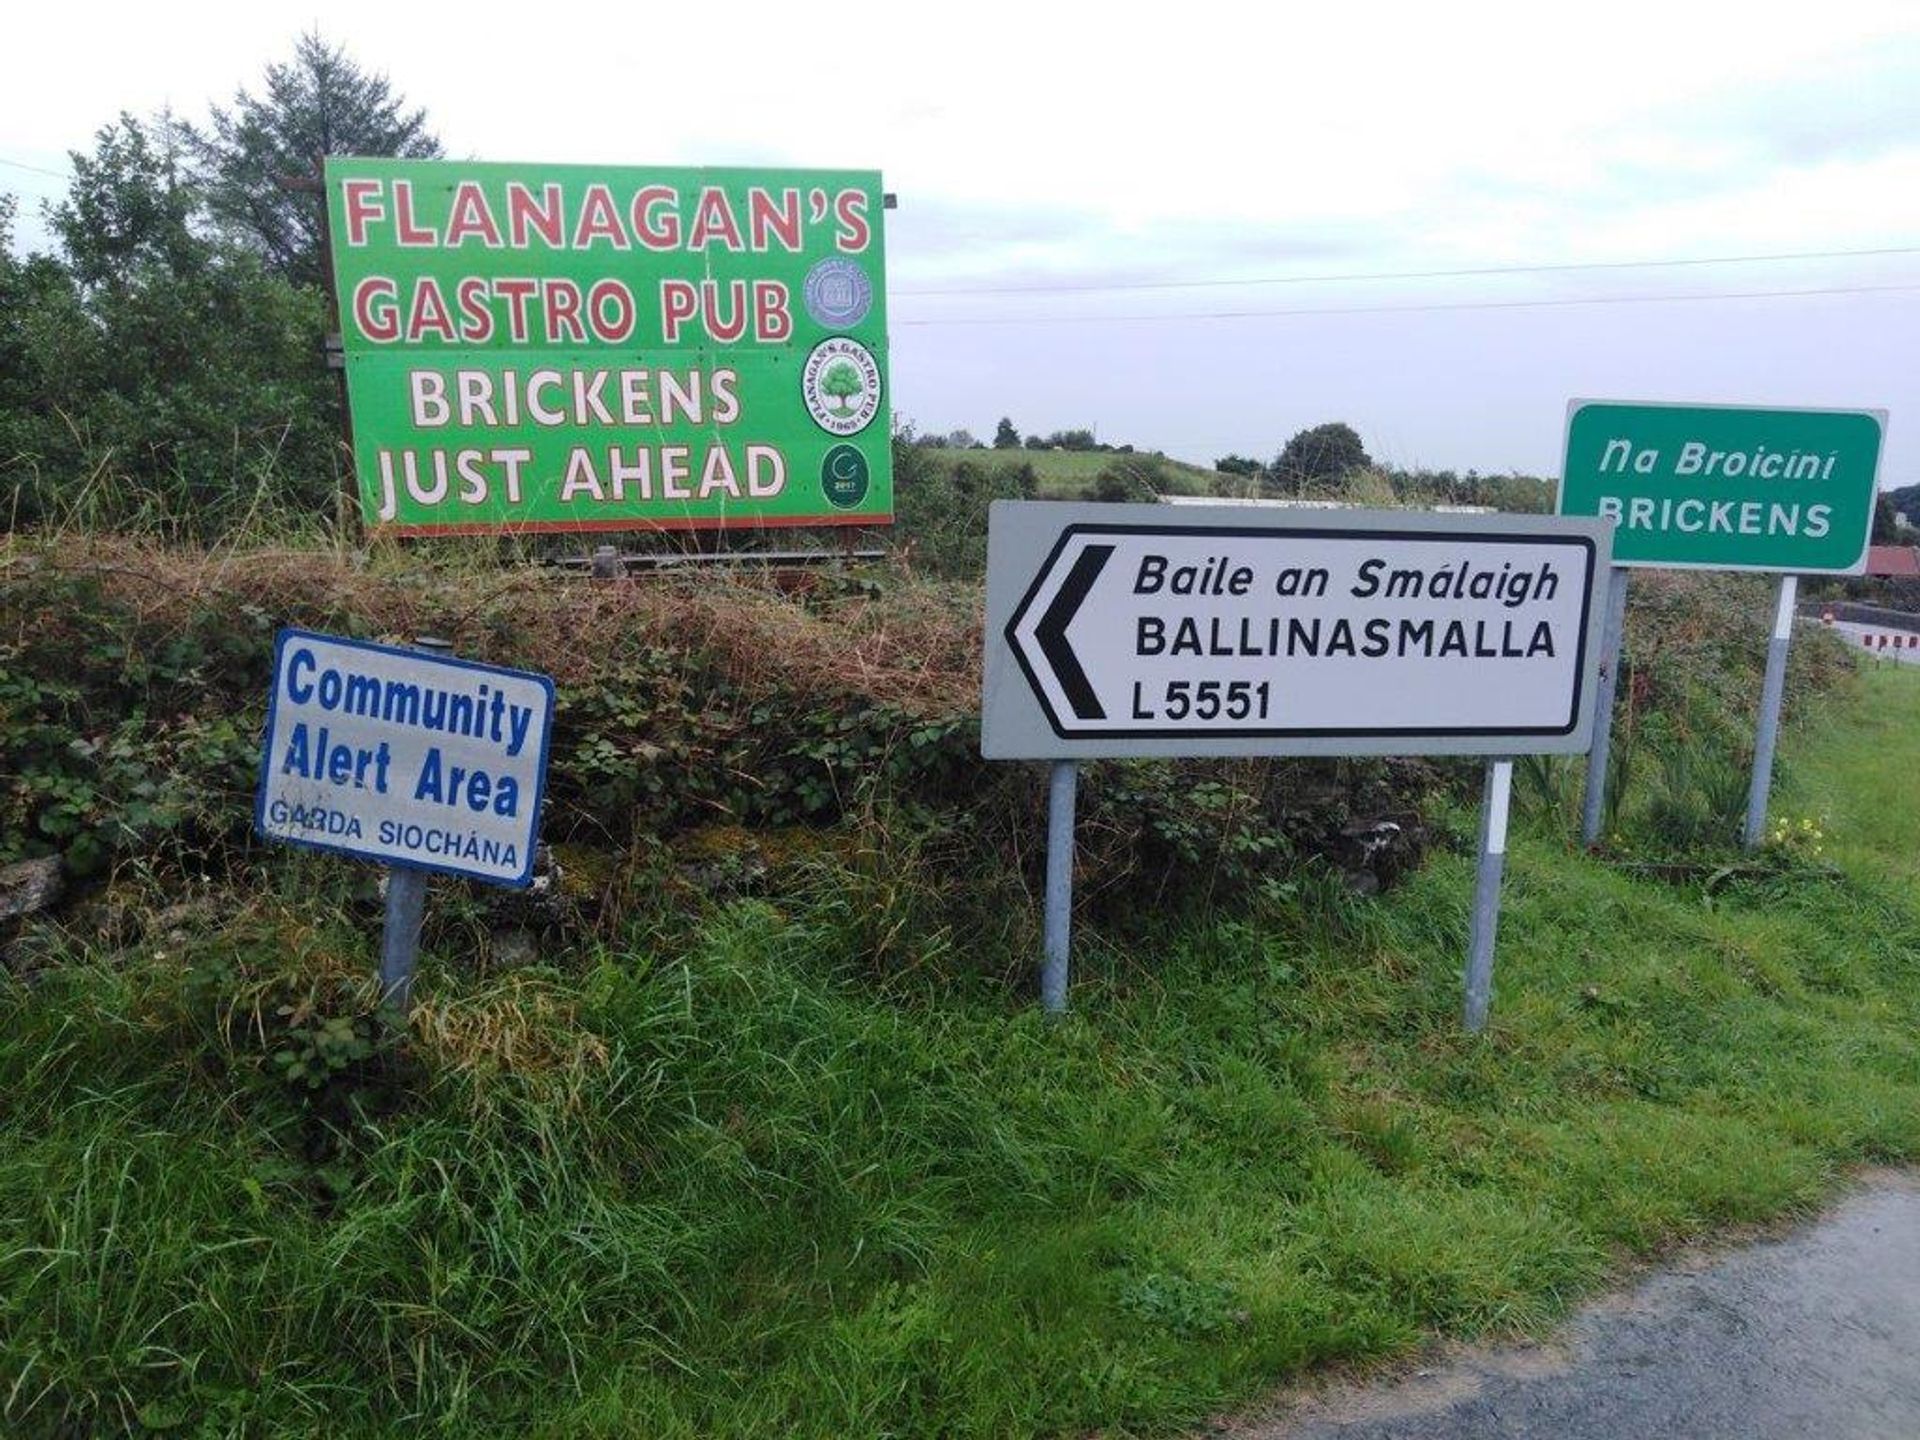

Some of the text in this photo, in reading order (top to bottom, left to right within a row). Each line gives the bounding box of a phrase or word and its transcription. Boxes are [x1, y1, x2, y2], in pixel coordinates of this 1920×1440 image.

[342, 179, 871, 252] FLANAGAN'S
[352, 276, 636, 343] GASTRO
[660, 278, 794, 343] PUB
[840, 343, 877, 388] GASTRO
[410, 368, 741, 427] BRICKENS
[378, 445, 786, 522] JUST AHEAD
[1674, 442, 1838, 480] Broicíní
[1600, 496, 1833, 538] BRICKENS
[1133, 554, 1560, 608] Baile an Smálaigh
[1136, 616, 1556, 659] BALLINASMALLA
[287, 648, 532, 756] Community
[282, 722, 520, 818] Alert Area
[269, 800, 518, 868] GARDA SIOCHÁNA
